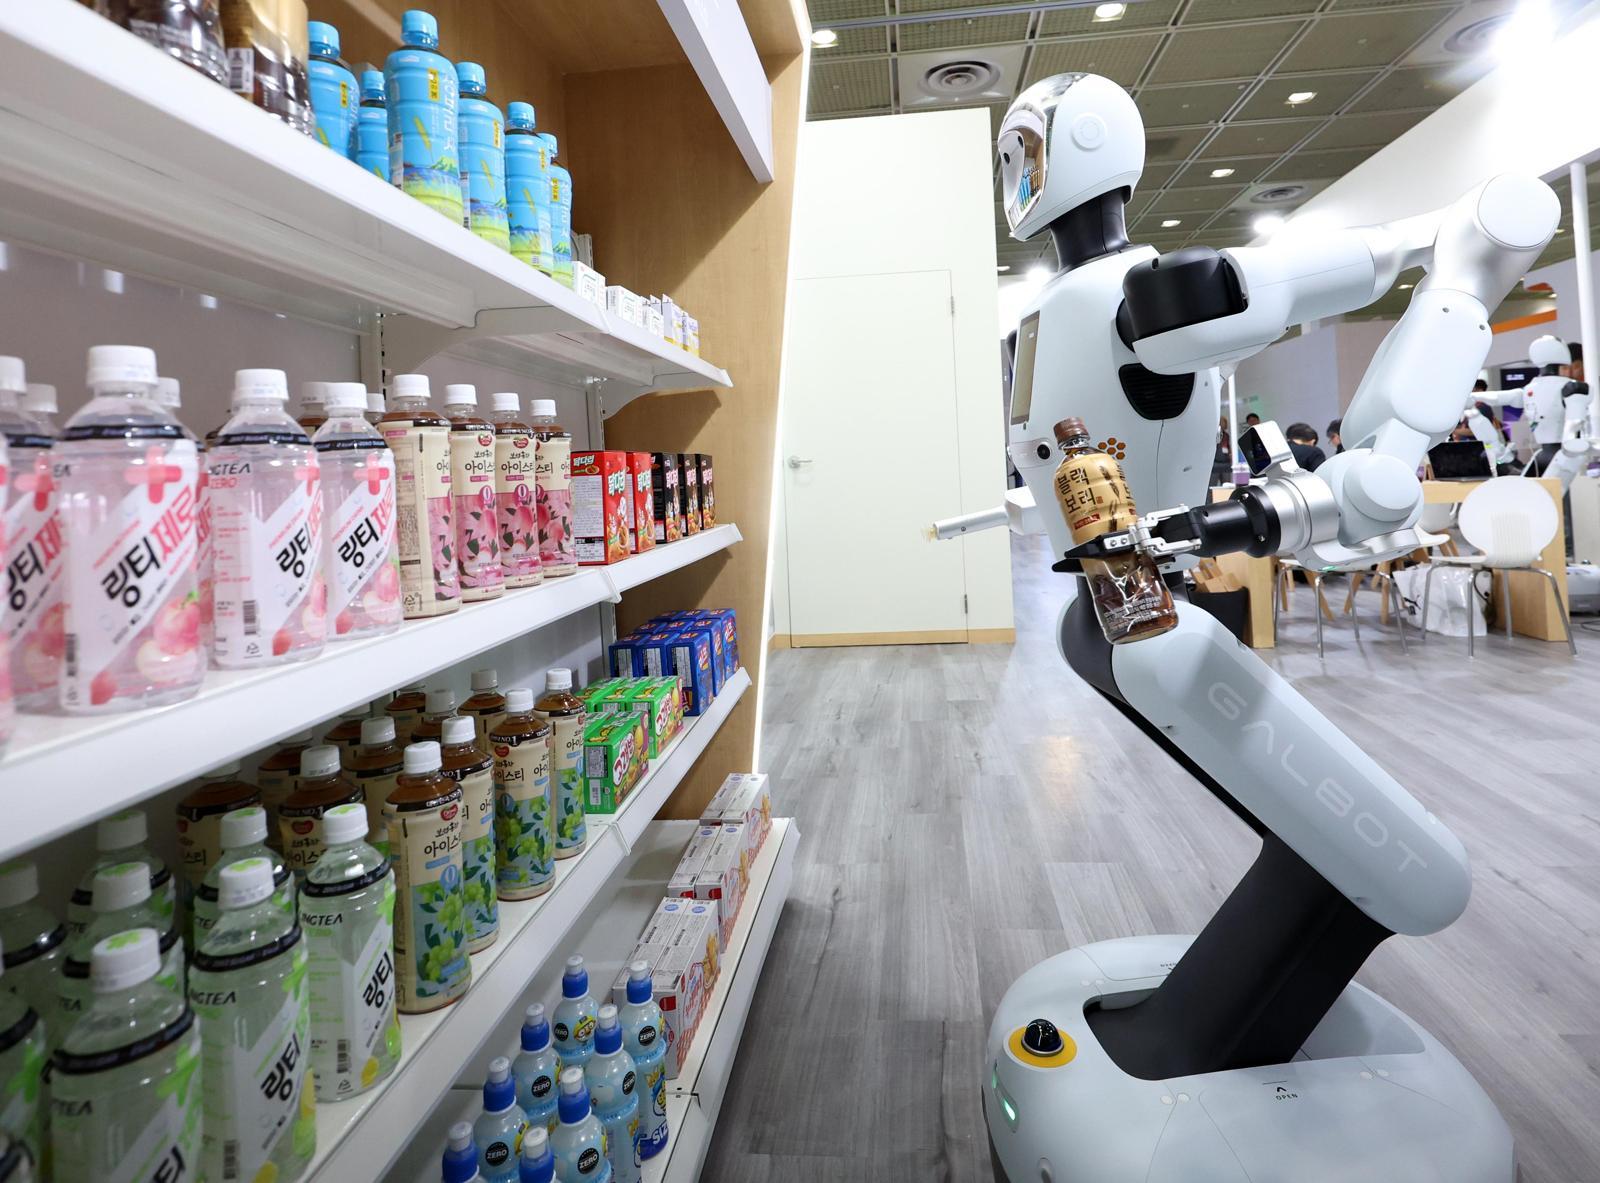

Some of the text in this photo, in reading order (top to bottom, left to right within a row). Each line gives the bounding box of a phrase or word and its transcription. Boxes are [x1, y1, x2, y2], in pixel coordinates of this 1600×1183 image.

[464, 460, 495, 475] 아이스
[535, 462, 554, 474] 스티
[496, 767, 525, 782] 이스티
[1208, 682, 1427, 873] GALBOT
[424, 836, 461, 858] 아이스
[638, 1030, 658, 1043] ZERO
[532, 1080, 551, 1093] ZERO
[485, 1148, 509, 1160] ZERO
[578, 1154, 600, 1171] ZERO
